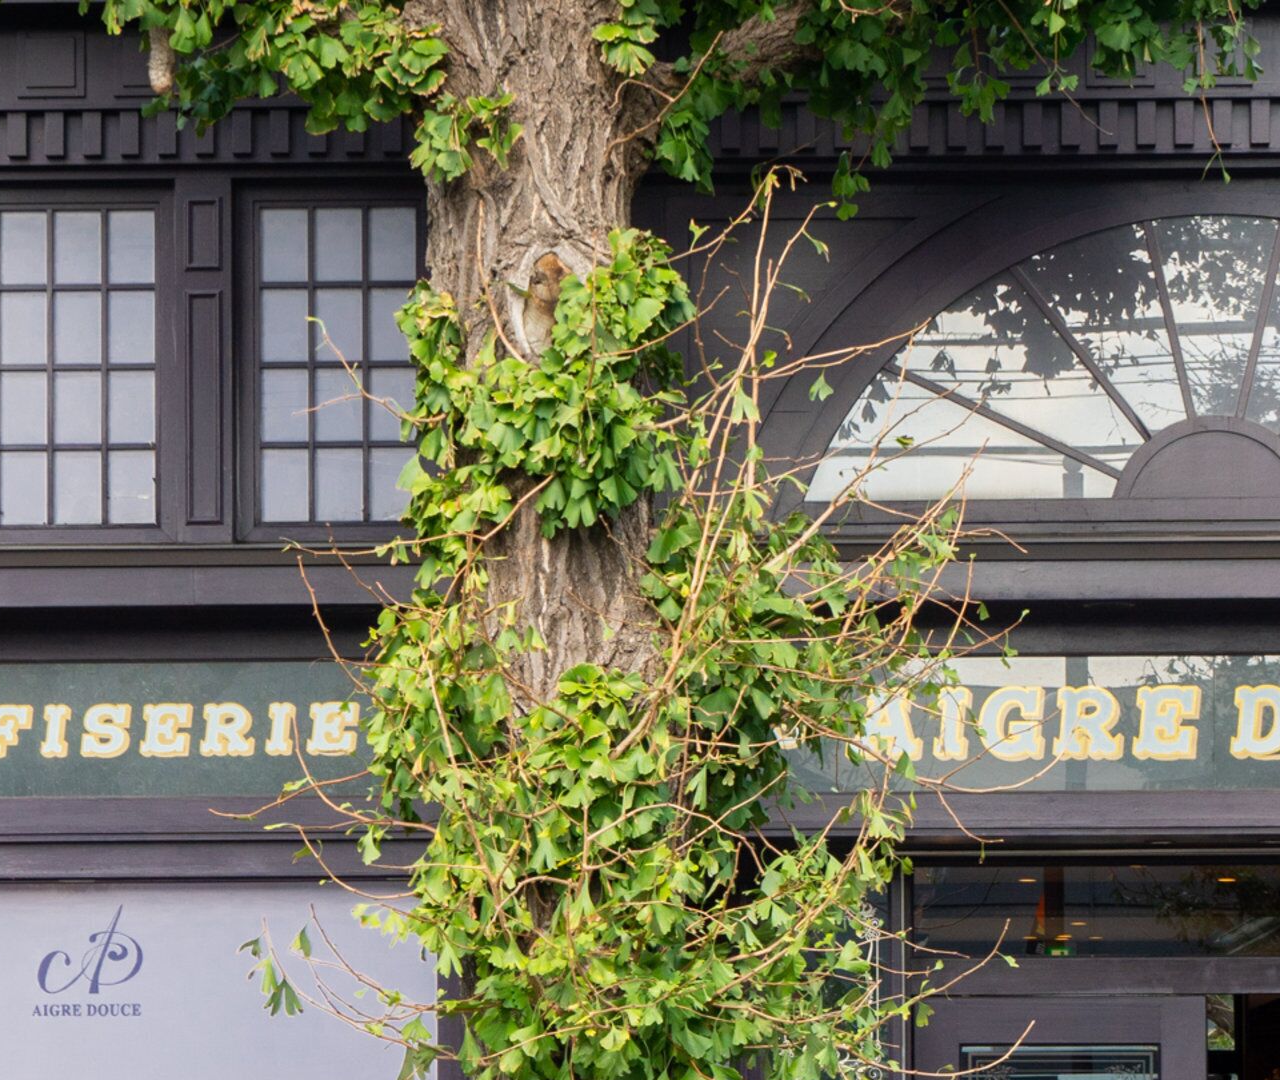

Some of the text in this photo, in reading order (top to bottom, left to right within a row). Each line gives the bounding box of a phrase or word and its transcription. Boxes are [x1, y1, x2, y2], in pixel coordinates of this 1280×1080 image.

[844, 684, 1201, 761] AIGRE
[32, 1003, 142, 1017] AIGRE DOUCE
